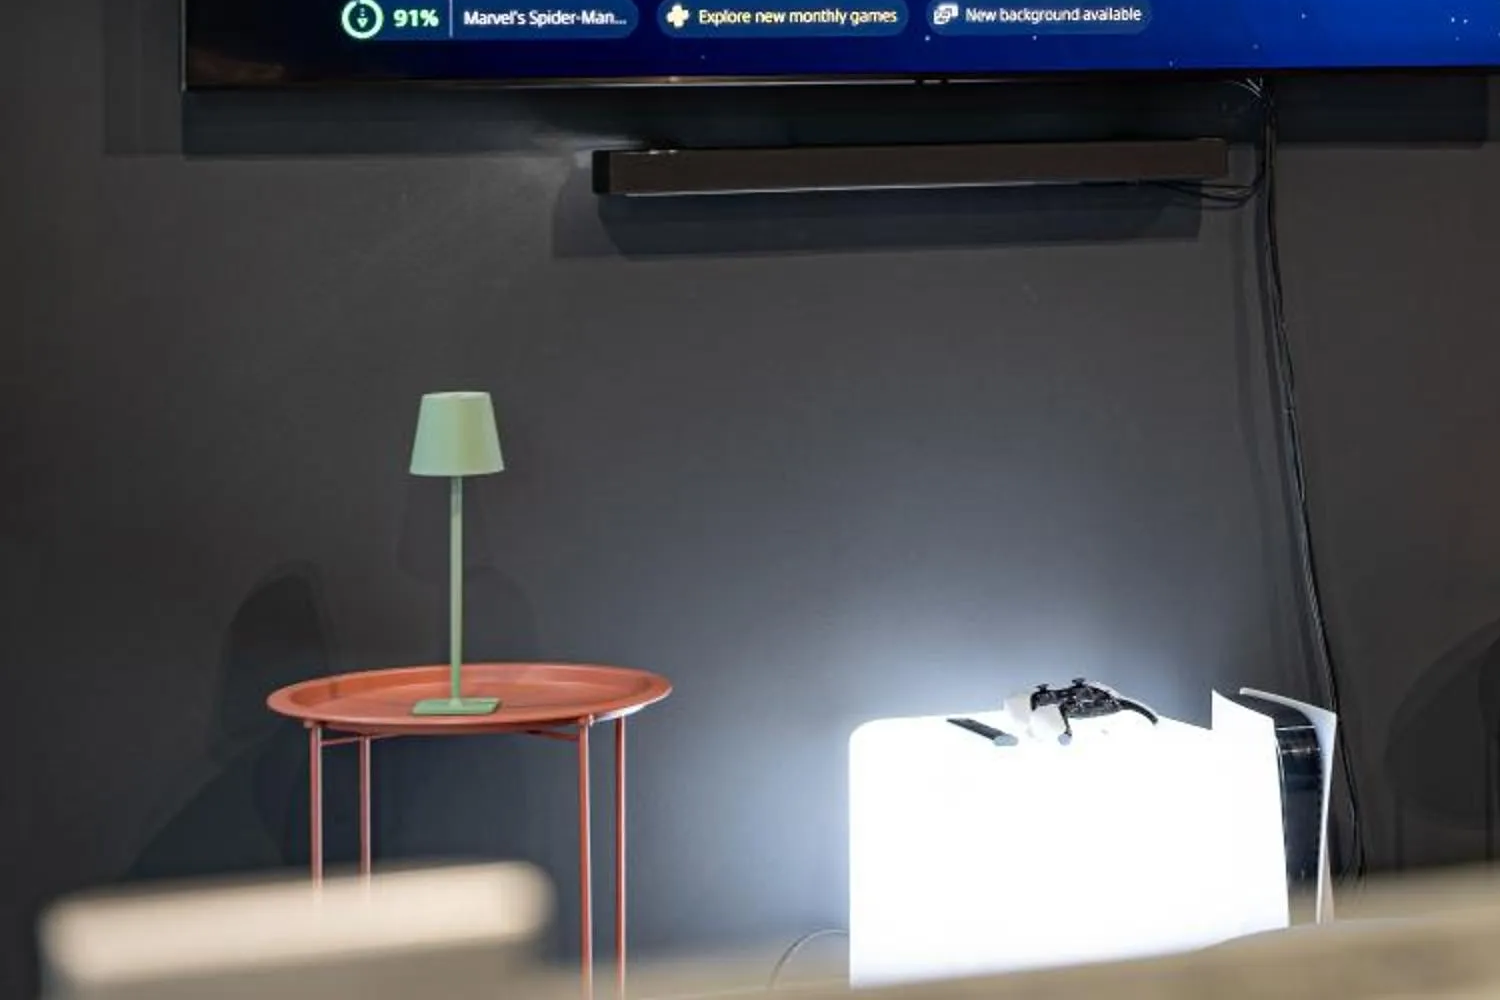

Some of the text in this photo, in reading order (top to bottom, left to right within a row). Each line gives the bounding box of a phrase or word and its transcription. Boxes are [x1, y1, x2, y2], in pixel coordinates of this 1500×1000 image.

[394, 9, 439, 27] 91%
[464, 11, 526, 25] Marvel's
[699, 8, 897, 26] Explore new monthly games
[966, 8, 1142, 24] New background available
